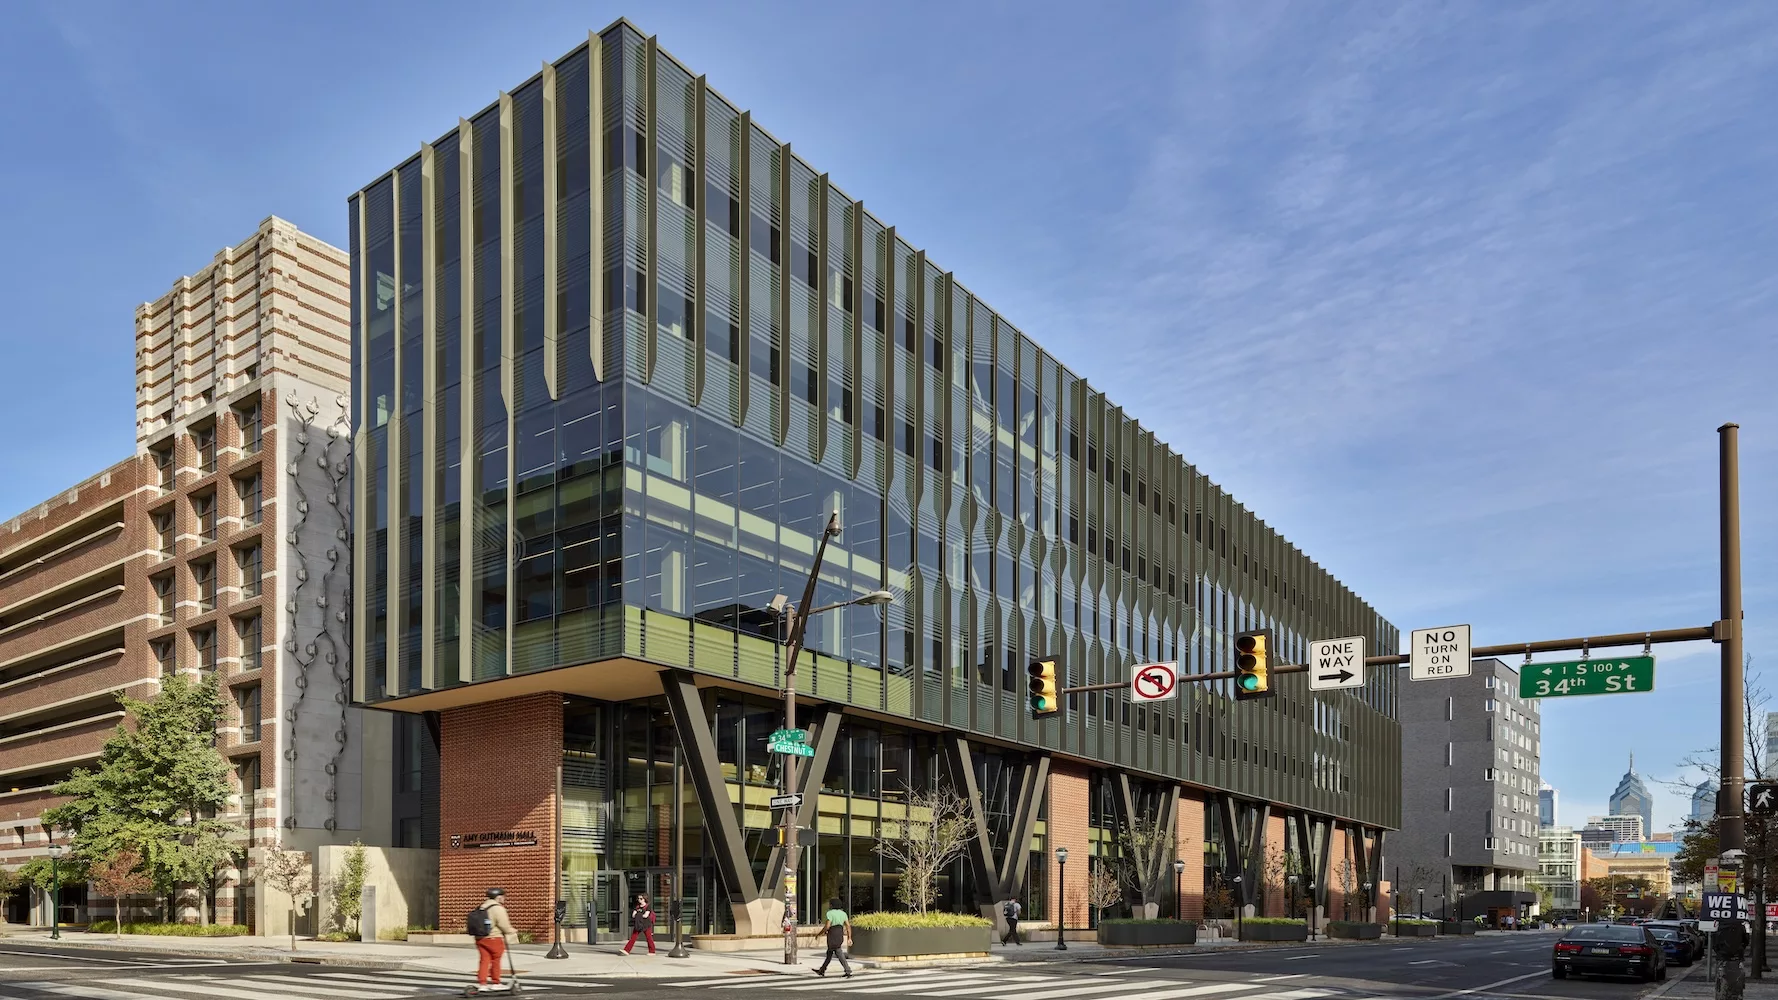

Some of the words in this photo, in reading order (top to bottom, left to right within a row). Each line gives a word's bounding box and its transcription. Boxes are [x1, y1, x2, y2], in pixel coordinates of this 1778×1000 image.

[1426, 631, 1455, 644] NO
[1321, 643, 1353, 656] ONE
[1424, 644, 1458, 655] TURN
[1320, 655, 1354, 668] WAY
[1431, 655, 1450, 665] ON
[1428, 665, 1453, 675] RED
[1576, 664, 1588, 675] S
[1593, 663, 1613, 672] 100
[1535, 677, 1586, 696] 34th
[1605, 674, 1636, 691] St
[775, 744, 806, 755] CHESTNUT
[463, 834, 478, 842] AMY
[1708, 896, 1732, 908] WE
[1710, 910, 1731, 919] GO
